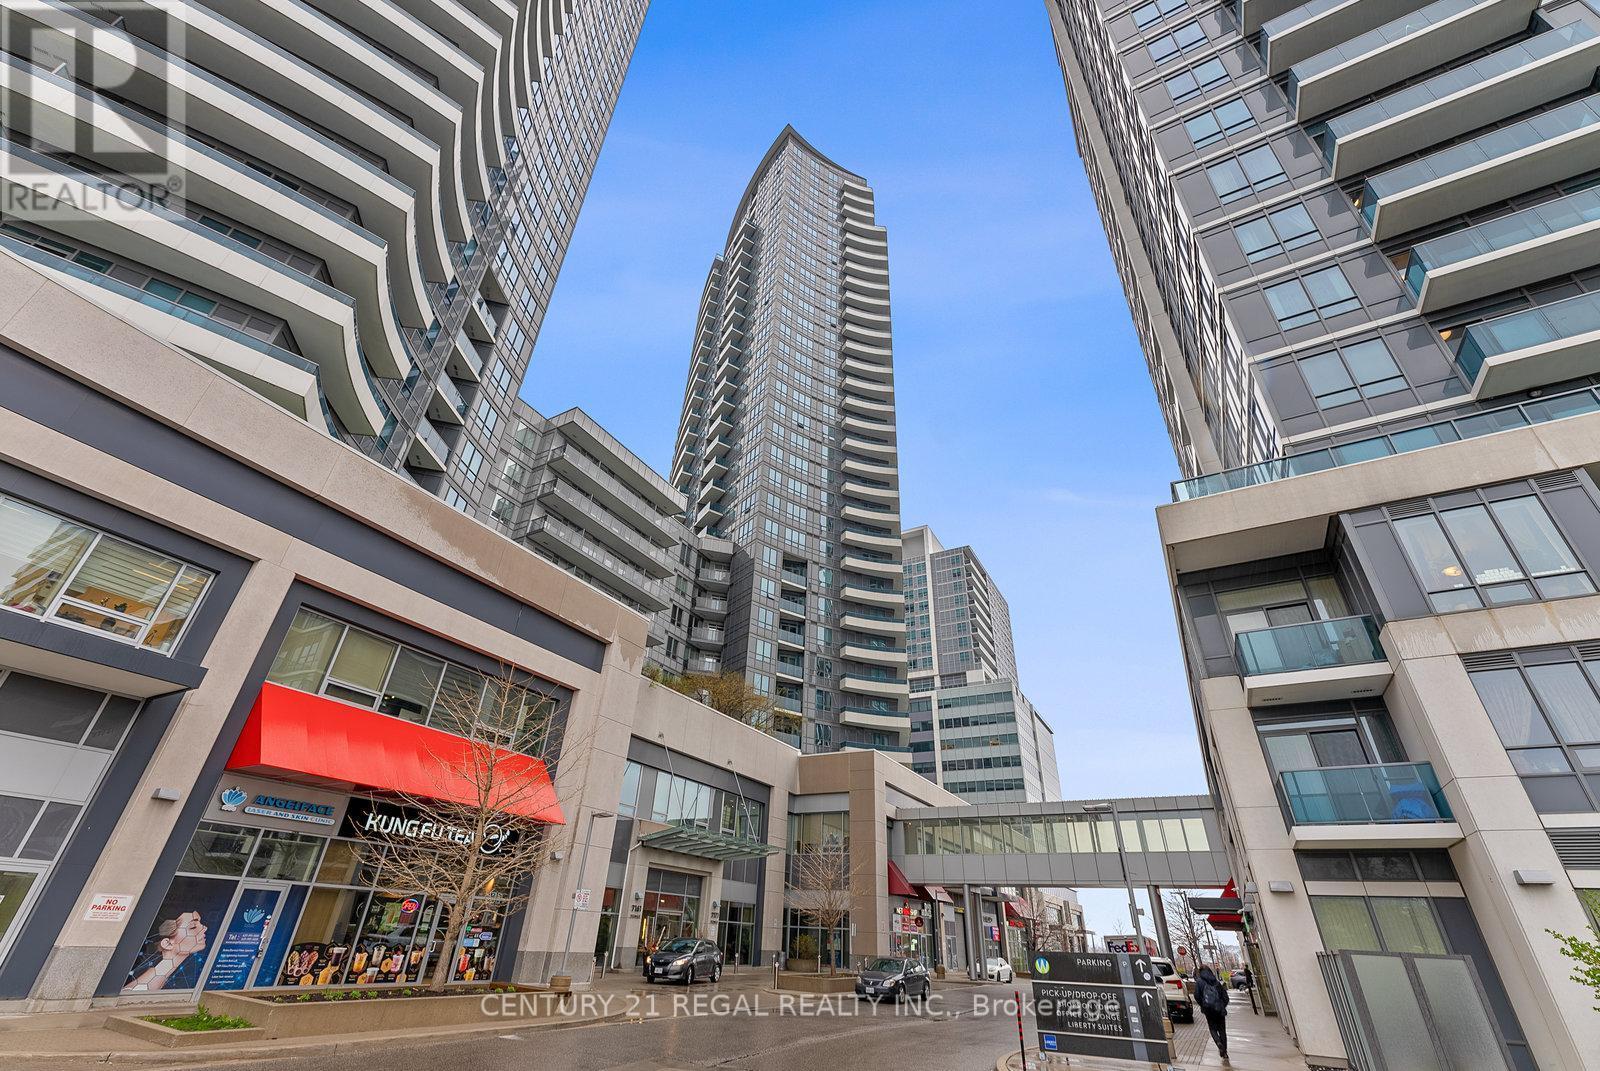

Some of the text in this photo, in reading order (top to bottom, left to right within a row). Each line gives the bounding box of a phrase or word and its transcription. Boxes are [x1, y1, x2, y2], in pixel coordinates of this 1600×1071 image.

[247, 807, 273, 816] LASER
[290, 813, 309, 821] SKIN
[309, 816, 334, 825] CLINIC
[364, 812, 420, 838] KUNG
[420, 822, 445, 841] FU
[91, 904, 127, 912] PARKING
[1107, 940, 1140, 953] FedEx
[1076, 958, 1112, 967] PARKING
[1041, 989, 1117, 1000] PICK-UP/DROP-OFF
[1067, 1021, 1123, 1032] LIBERTY SUITES
